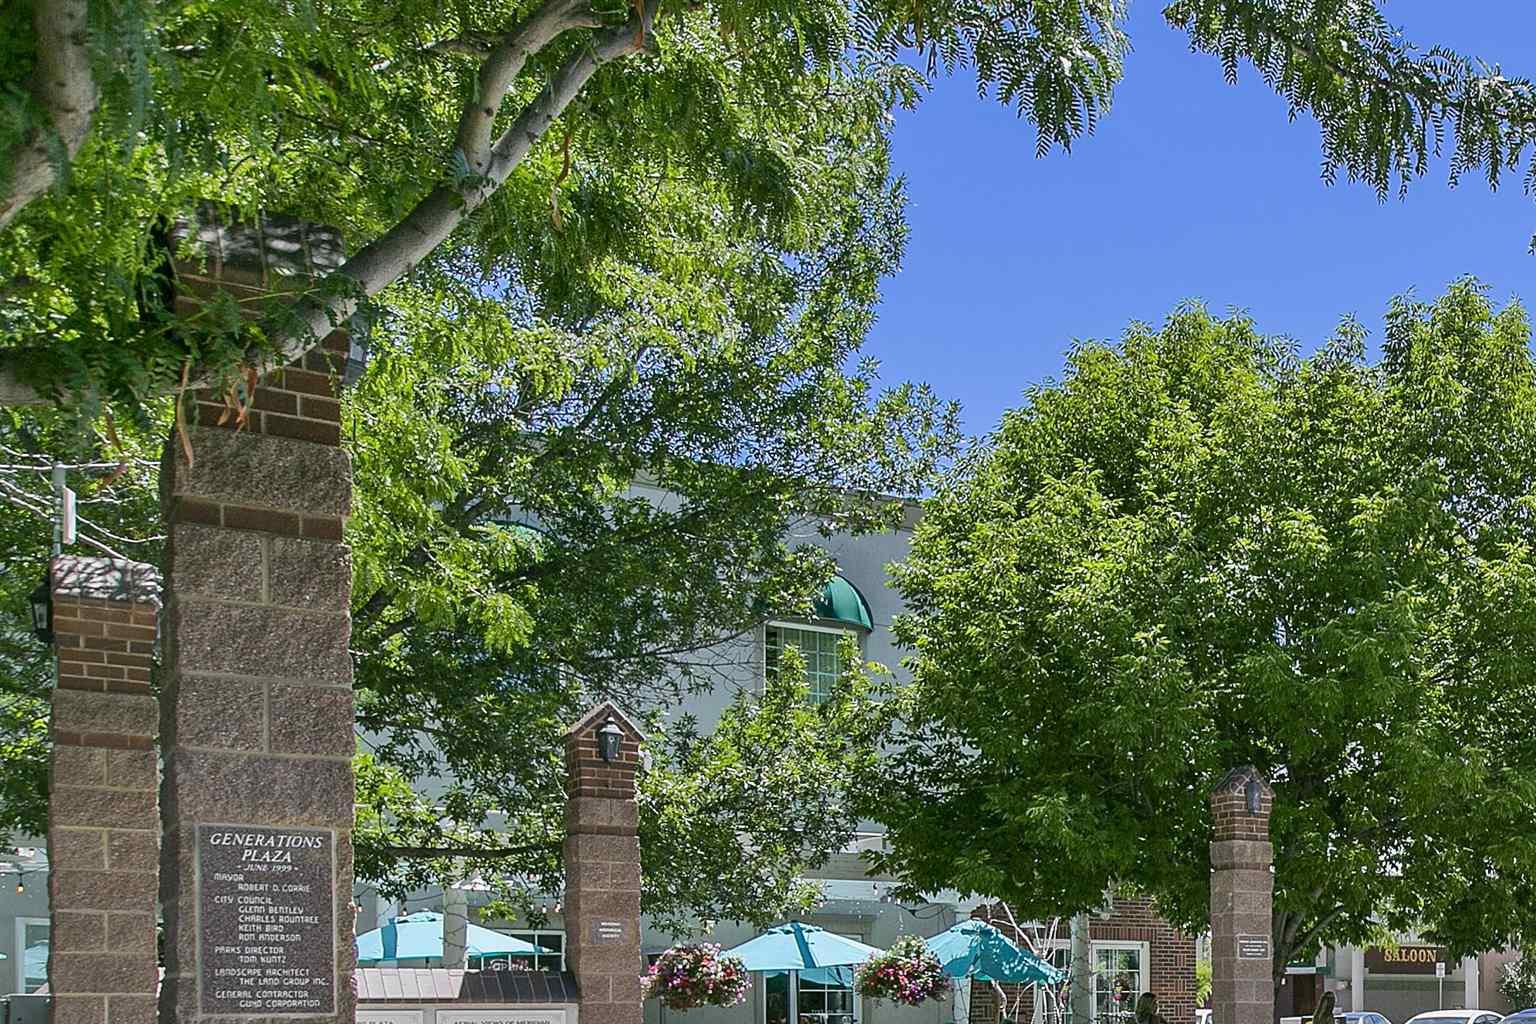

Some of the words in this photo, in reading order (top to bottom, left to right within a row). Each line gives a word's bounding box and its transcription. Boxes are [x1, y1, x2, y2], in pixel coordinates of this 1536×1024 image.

[209, 833, 324, 848] GENERATIONS
[241, 849, 292, 863] PLAZA
[272, 864, 292, 872] 1999
[214, 873, 244, 882] MAYOR
[238, 883, 269, 892] ROBERT
[214, 895, 234, 904] CITY
[238, 896, 273, 905] COUNCIL
[238, 906, 266, 914] GLENN
[269, 906, 304, 914] BENTLEY
[238, 914, 276, 923] CHARLES
[279, 915, 320, 924] ROUNTREE
[238, 924, 262, 932] KEITH
[265, 925, 284, 933] BIRD
[258, 934, 302, 942] ANDERSON
[215, 946, 241, 954] PARKS
[244, 946, 284, 955] DIRECTOR
[239, 955, 258, 964] TOM
[261, 956, 287, 964] KUNTZ
[1384, 948, 1437, 963] SALOON
[214, 968, 262, 977] LANDSCAPE
[265, 968, 310, 977] ARCHITECT
[239, 978, 255, 986] THE
[258, 977, 280, 986] LAND
[282, 978, 310, 986] GROUP
[215, 990, 253, 999] GENERAL
[255, 990, 309, 999] CONTRACTOR
[265, 999, 321, 1008] CORPORATION
